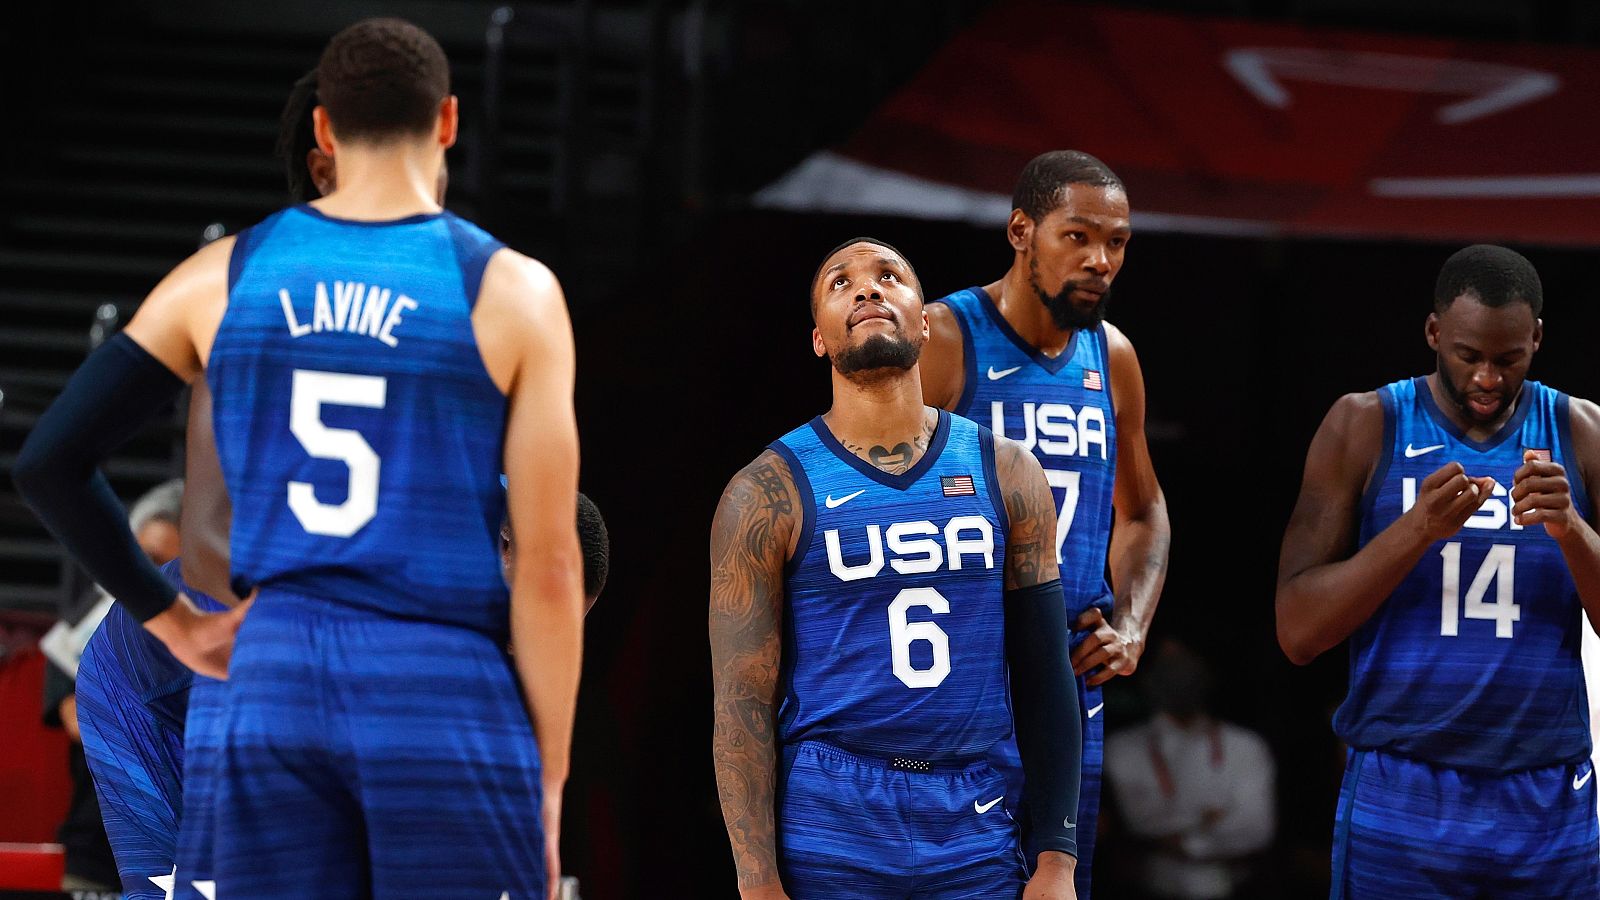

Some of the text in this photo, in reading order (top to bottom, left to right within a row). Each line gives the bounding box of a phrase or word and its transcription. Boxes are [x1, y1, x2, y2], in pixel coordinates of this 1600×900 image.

[278, 280, 418, 347] LAVINE
[287, 368, 387, 538] 5
[991, 401, 1107, 460] USA
[824, 515, 994, 582] USA
[1043, 469, 1081, 564] 7
[887, 587, 950, 688] 6
[1440, 542, 1520, 638] 14
